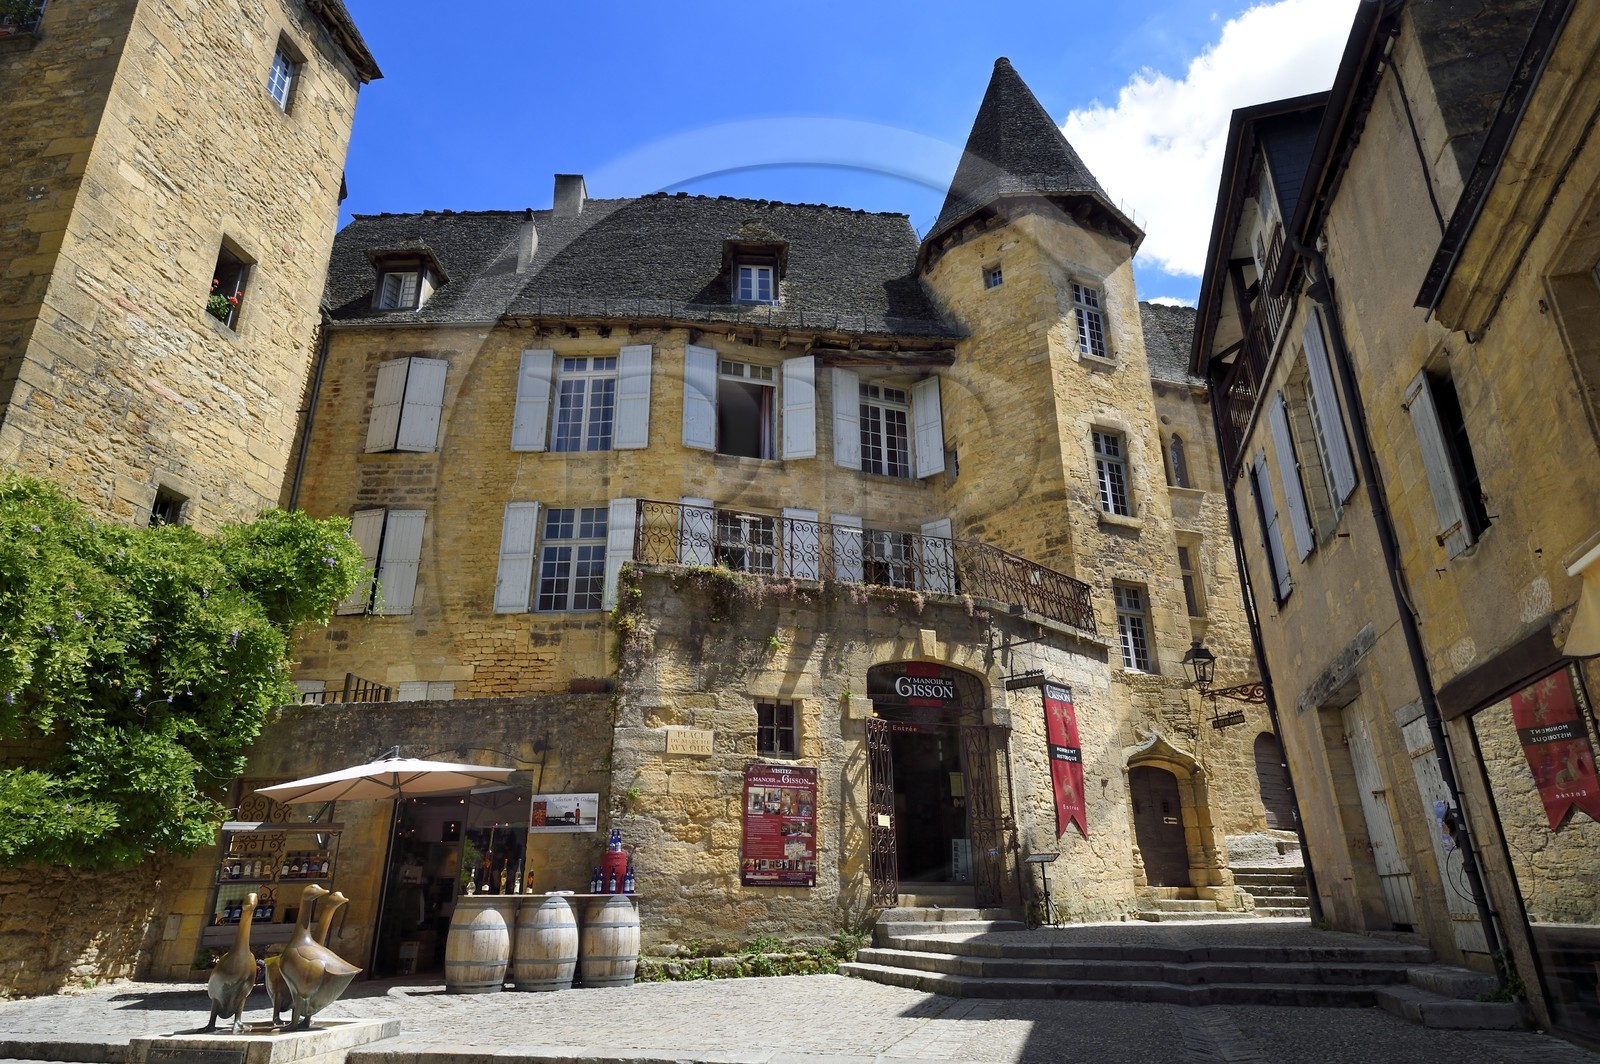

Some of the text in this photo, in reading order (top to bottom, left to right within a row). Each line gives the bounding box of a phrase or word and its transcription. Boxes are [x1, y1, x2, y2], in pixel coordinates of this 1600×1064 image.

[912, 677, 944, 685] MANOIR
[895, 676, 954, 698] GISSON
[892, 724, 918, 732] Entrée
[677, 731, 705, 739] PLACE
[689, 744, 711, 753] OIES
